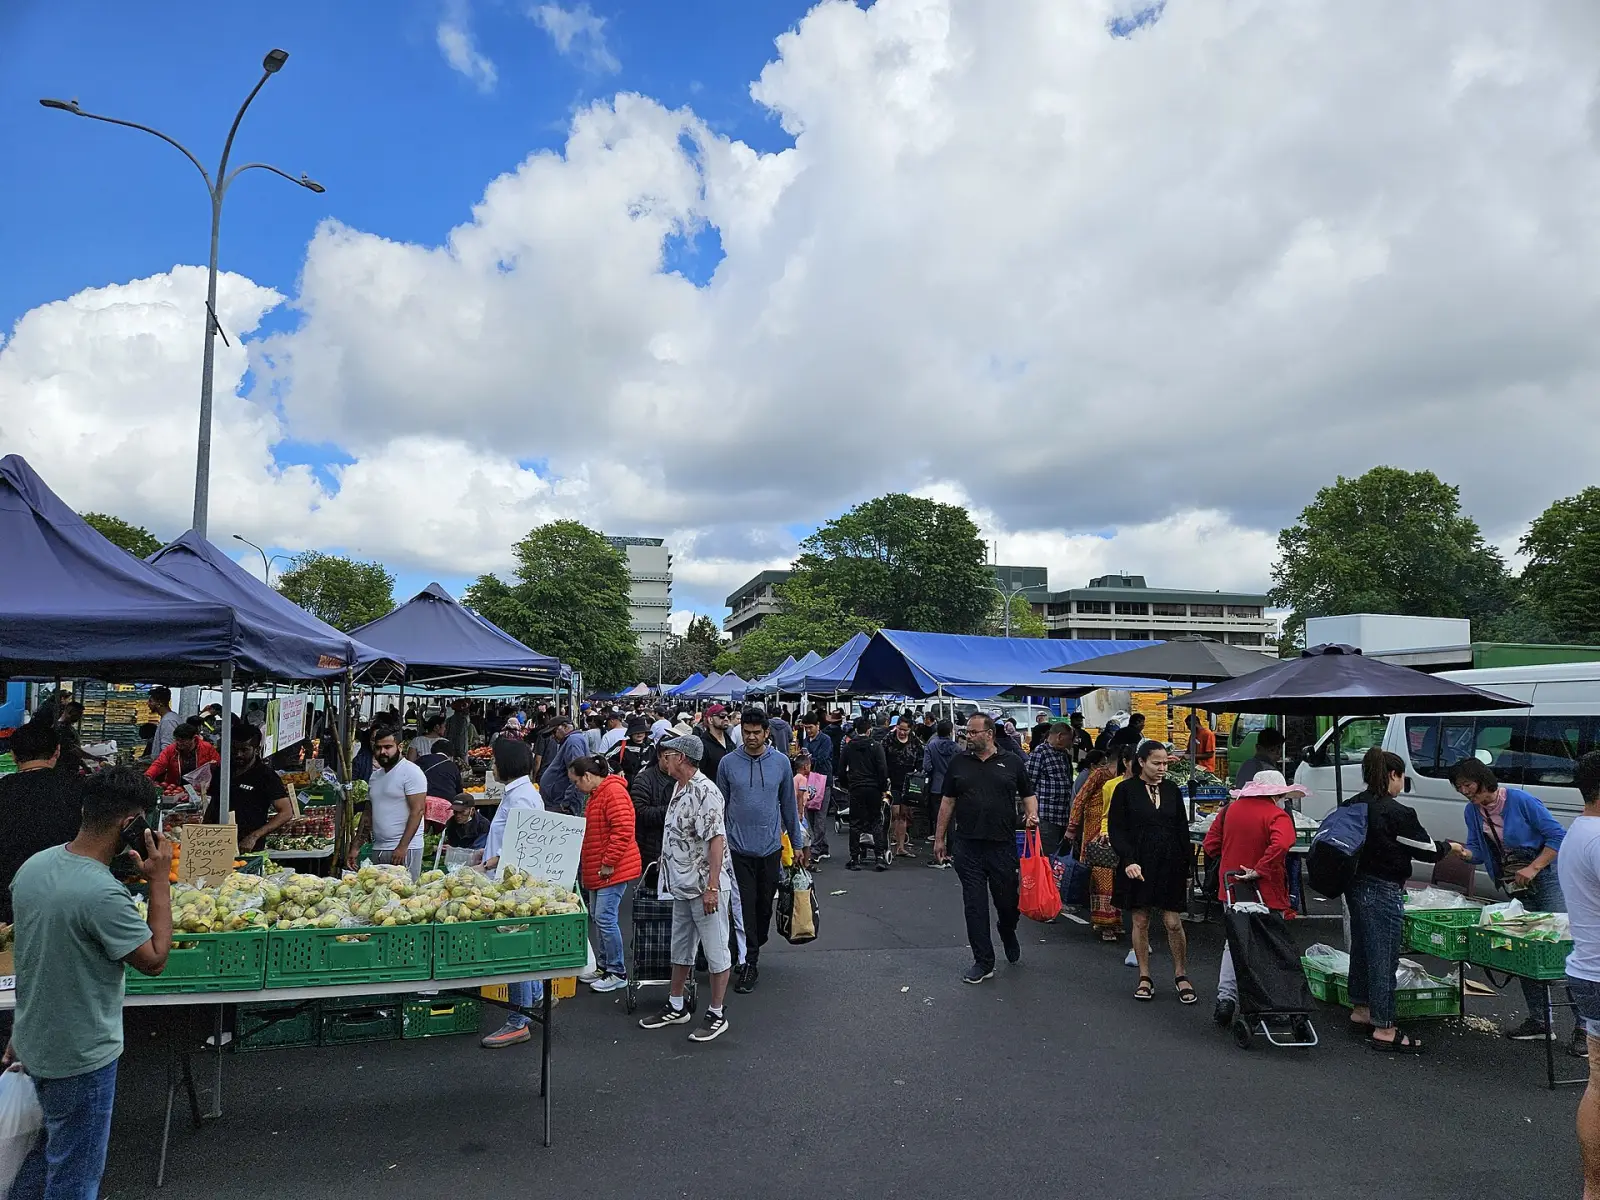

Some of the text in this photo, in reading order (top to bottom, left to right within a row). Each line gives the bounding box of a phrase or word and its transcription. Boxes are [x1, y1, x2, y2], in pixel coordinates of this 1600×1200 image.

[517, 811, 563, 832] Very
[186, 827, 224, 840] Very
[515, 831, 570, 848] pears
[185, 848, 226, 862] pears
[546, 865, 564, 881] bag
